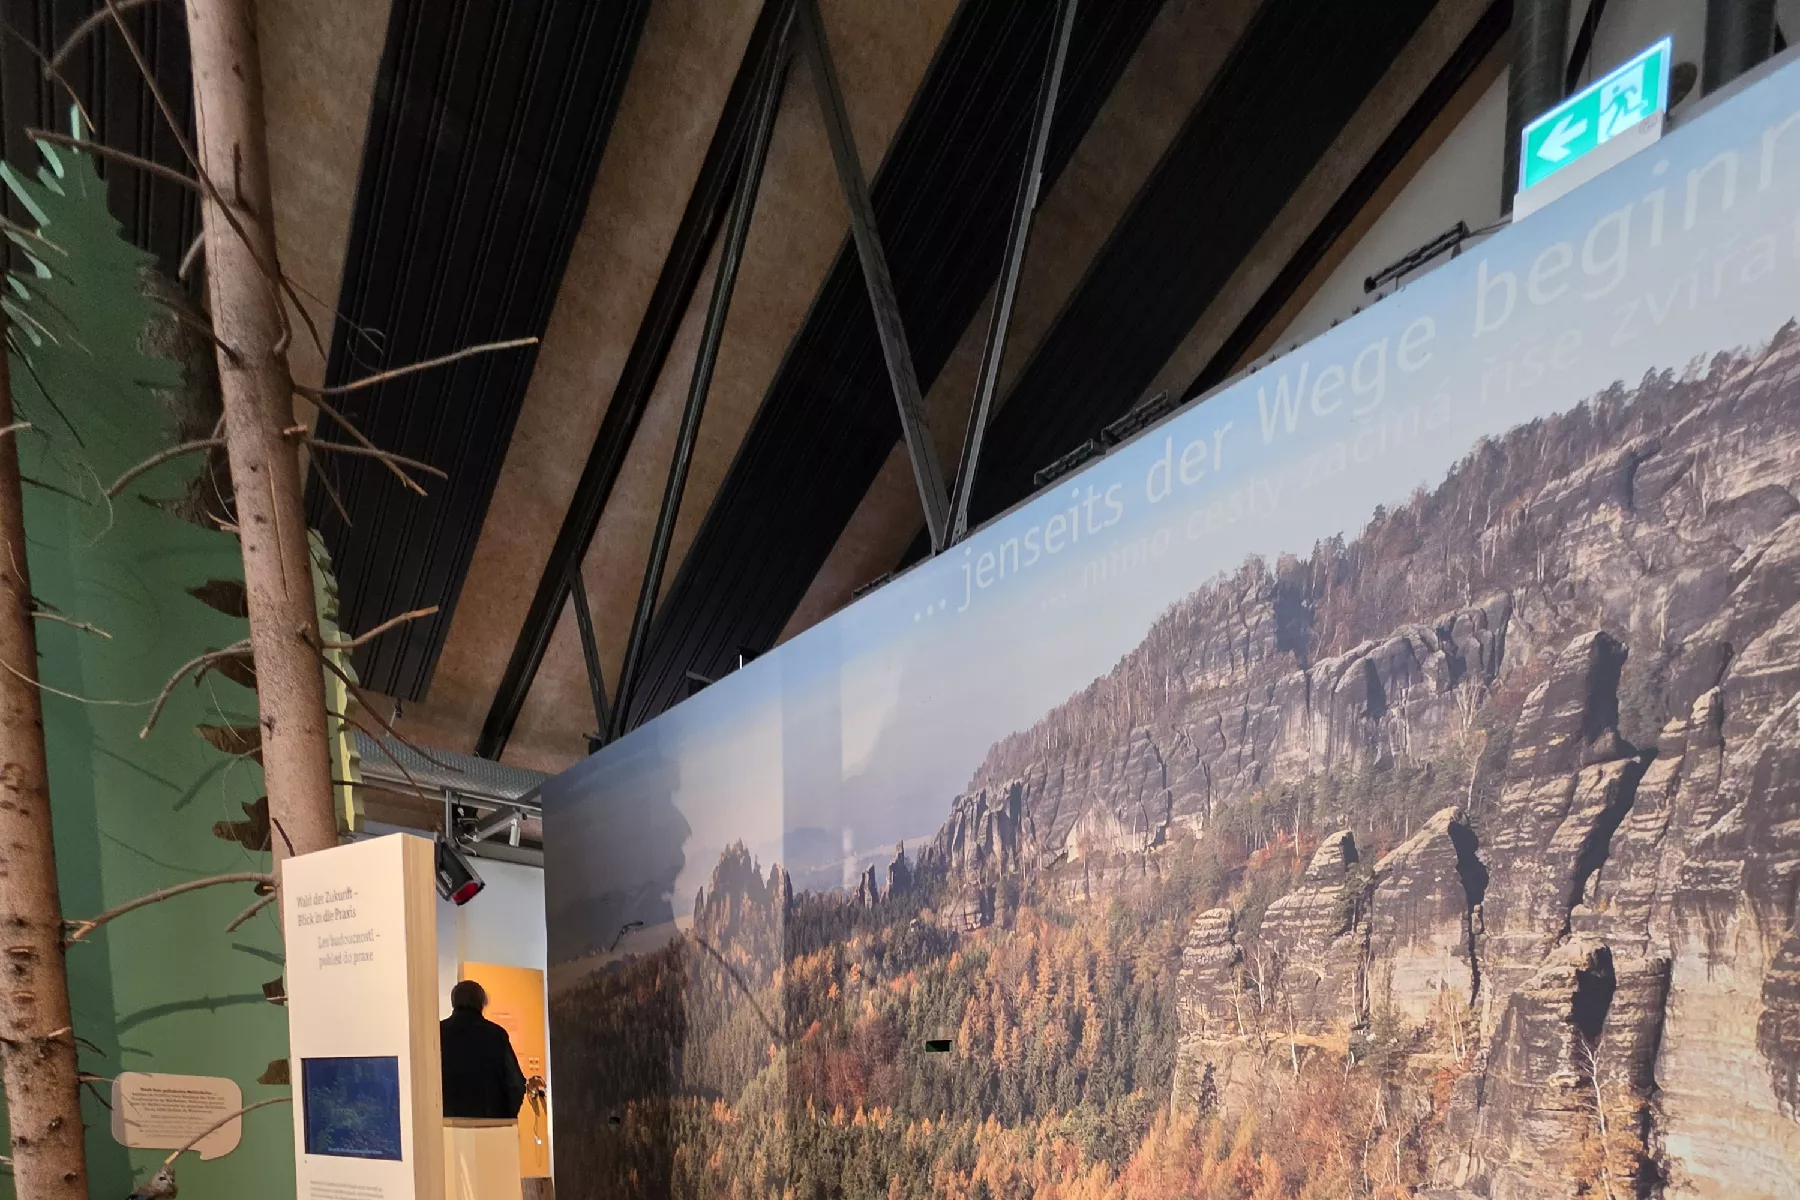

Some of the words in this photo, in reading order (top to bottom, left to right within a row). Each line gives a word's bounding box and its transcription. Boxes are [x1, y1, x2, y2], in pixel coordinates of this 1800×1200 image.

[957, 481, 1124, 613] jenseits
[1145, 419, 1233, 504] der
[1257, 315, 1436, 446] Wege
[1083, 527, 1171, 591] mimo
[1186, 473, 1285, 541] cesty
[313, 893, 324, 906] der
[325, 886, 353, 904] Zukunft
[297, 912, 315, 927] Blick
[315, 912, 323, 924] in
[323, 907, 334, 922] die
[335, 905, 357, 921] Praxis
[318, 936, 329, 949] Les
[319, 950, 342, 970] pohled
[342, 951, 352, 963] do
[353, 950, 374, 966] praxe
